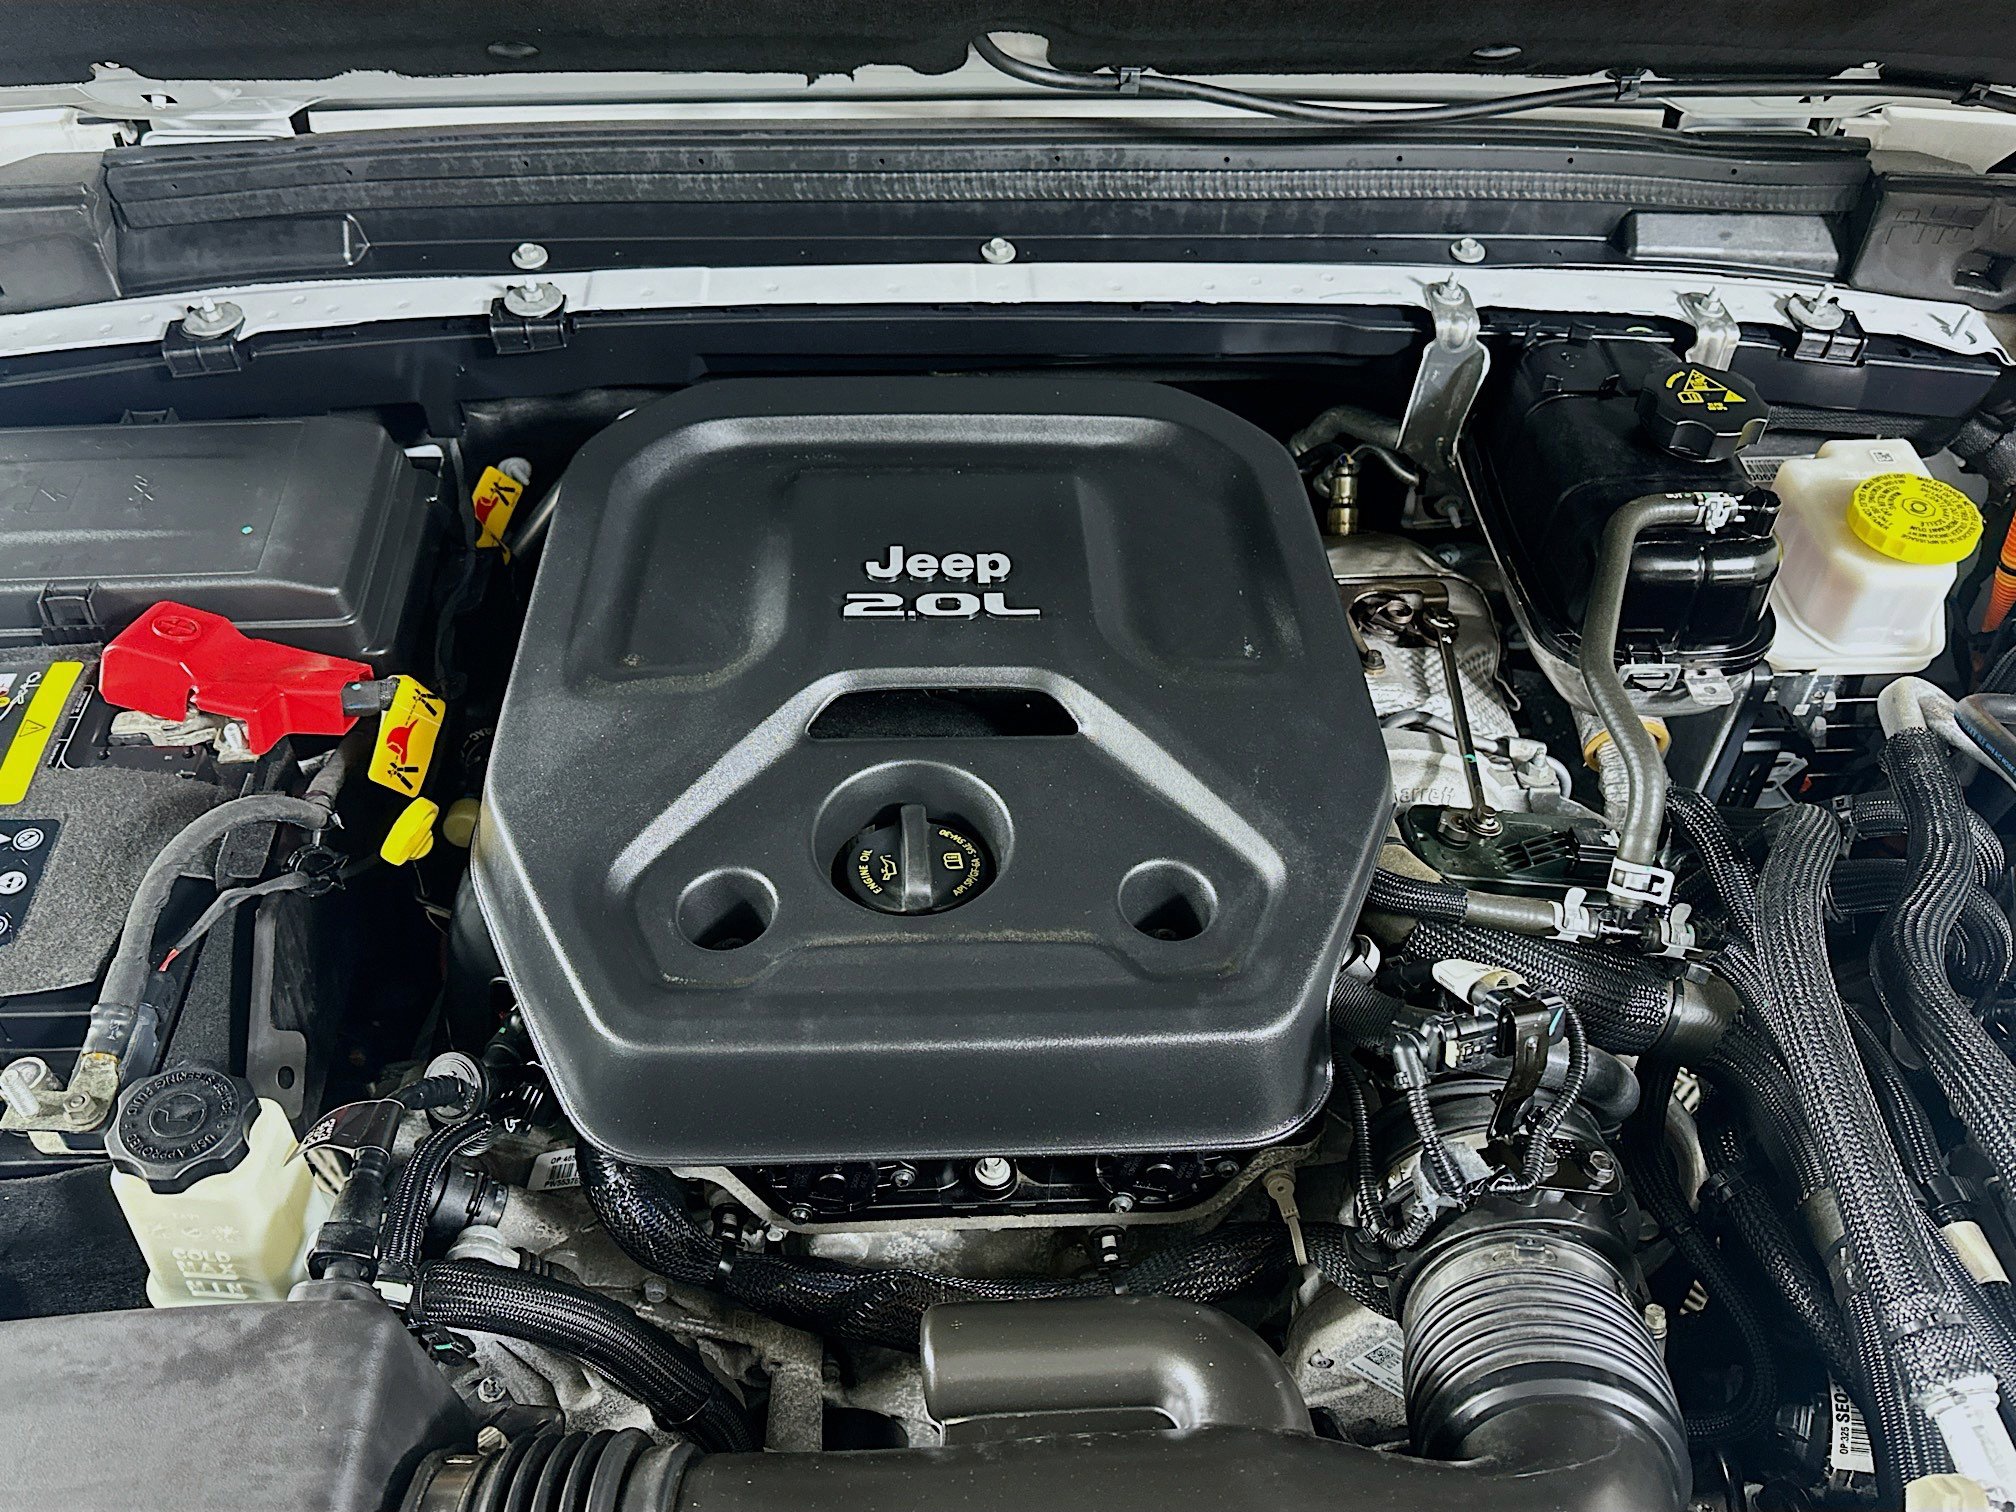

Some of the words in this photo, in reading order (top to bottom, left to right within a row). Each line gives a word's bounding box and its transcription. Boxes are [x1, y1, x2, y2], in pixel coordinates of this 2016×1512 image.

[865, 545, 1011, 585] Jeep
[843, 592, 1041, 619] 2.0L
[1395, 785, 1455, 803] arrett
[859, 849, 873, 862] OIL
[952, 885, 967, 897] API
[963, 842, 977, 856] SAE
[858, 864, 883, 895] ENGINE
[172, 1248, 231, 1263] COLD
[177, 1260, 237, 1274] MAX
[186, 1280, 244, 1293] MIN
